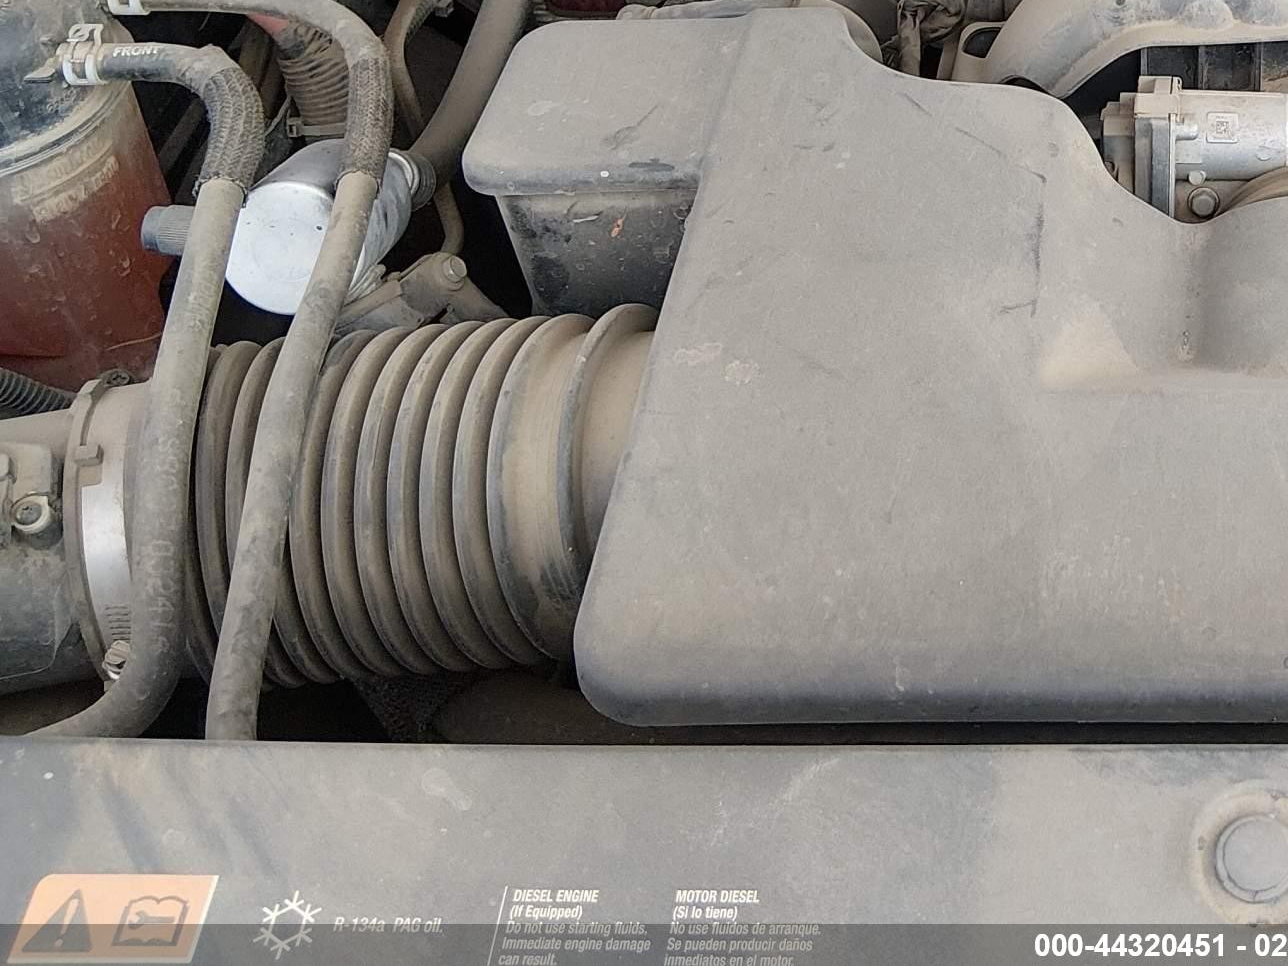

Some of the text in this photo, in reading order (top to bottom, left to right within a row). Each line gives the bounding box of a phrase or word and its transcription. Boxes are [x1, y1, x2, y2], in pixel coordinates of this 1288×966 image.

[113, 46, 162, 57] FRONT
[512, 889, 600, 903] DIESEL ENGINE
[675, 889, 760, 903] MOTOR DIESEL
[509, 905, 583, 920] (If Equipped)
[673, 905, 738, 921] (Si lo tiene)
[333, 916, 444, 933] R-134a PAG oil.
[505, 921, 648, 937] Do not use starting fluids.
[670, 921, 821, 938] No use fluidos de arranque.
[502, 937, 651, 953] Immediate engine damage
[667, 937, 813, 953] Se pueden producir daños
[498, 953, 557, 966] can result.
[664, 953, 794, 966] inmediatos en el motor.
